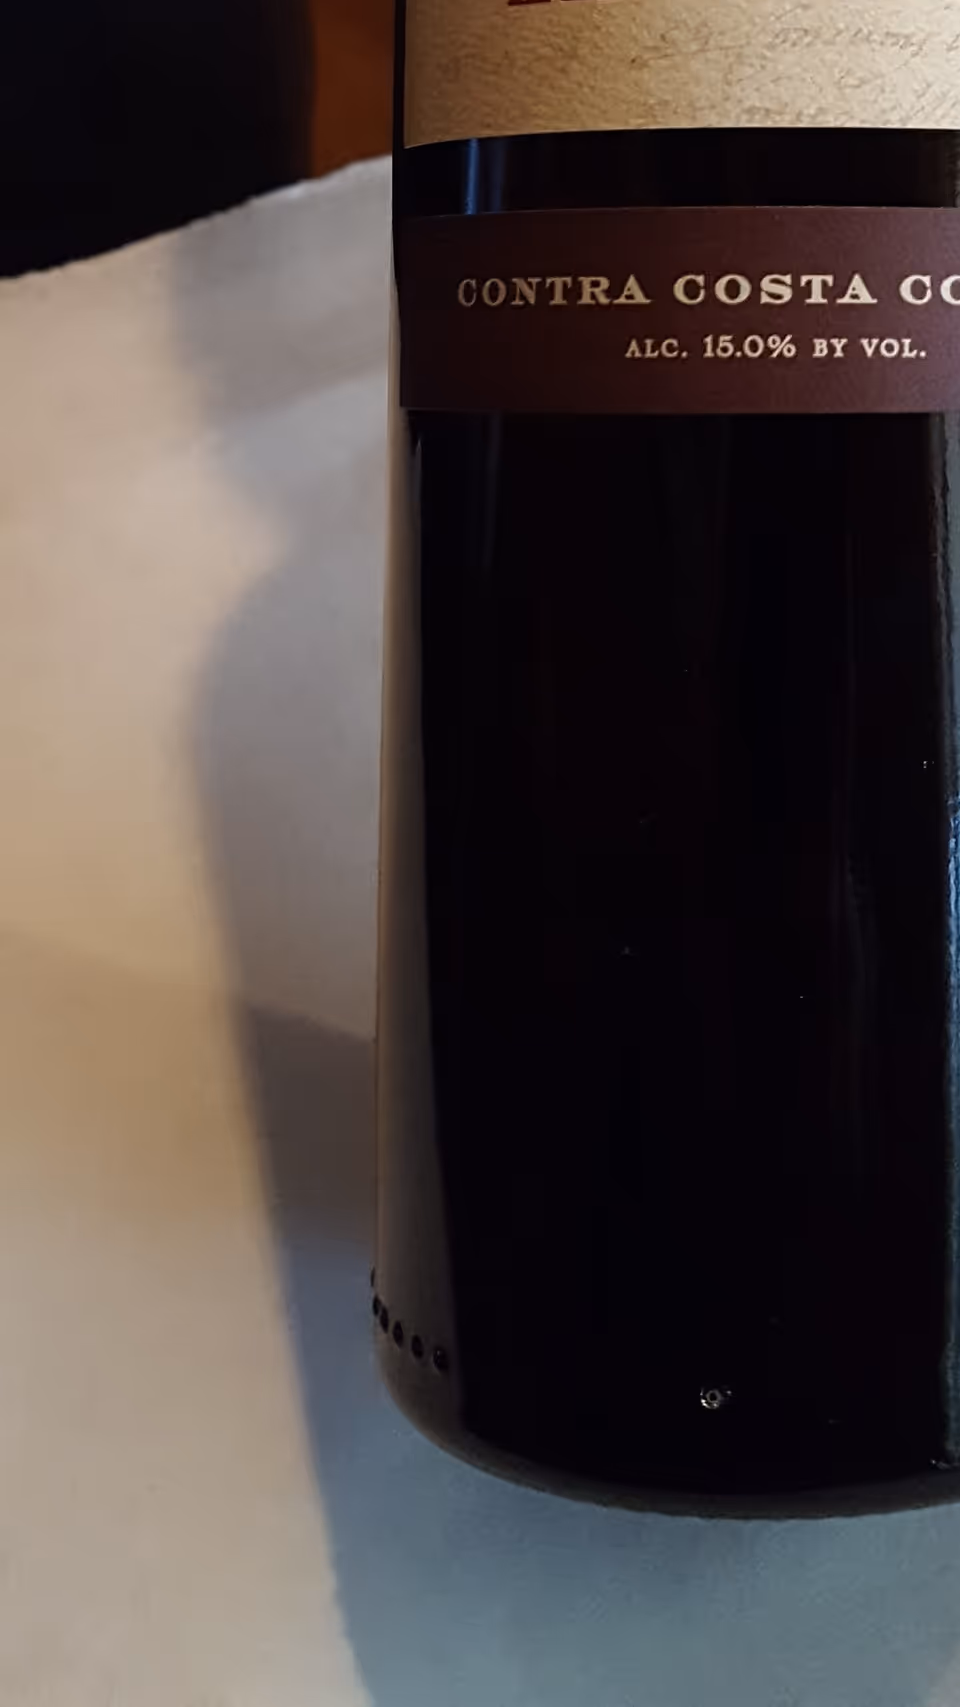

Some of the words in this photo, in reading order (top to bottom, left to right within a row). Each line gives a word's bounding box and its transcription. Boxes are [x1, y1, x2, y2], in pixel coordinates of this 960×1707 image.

[457, 274, 653, 307] CONTRA
[673, 273, 879, 306] COSTA
[624, 338, 689, 359] ALC.
[703, 333, 798, 360] 15.0%
[811, 337, 849, 359] BY
[859, 337, 928, 359] VOL.
